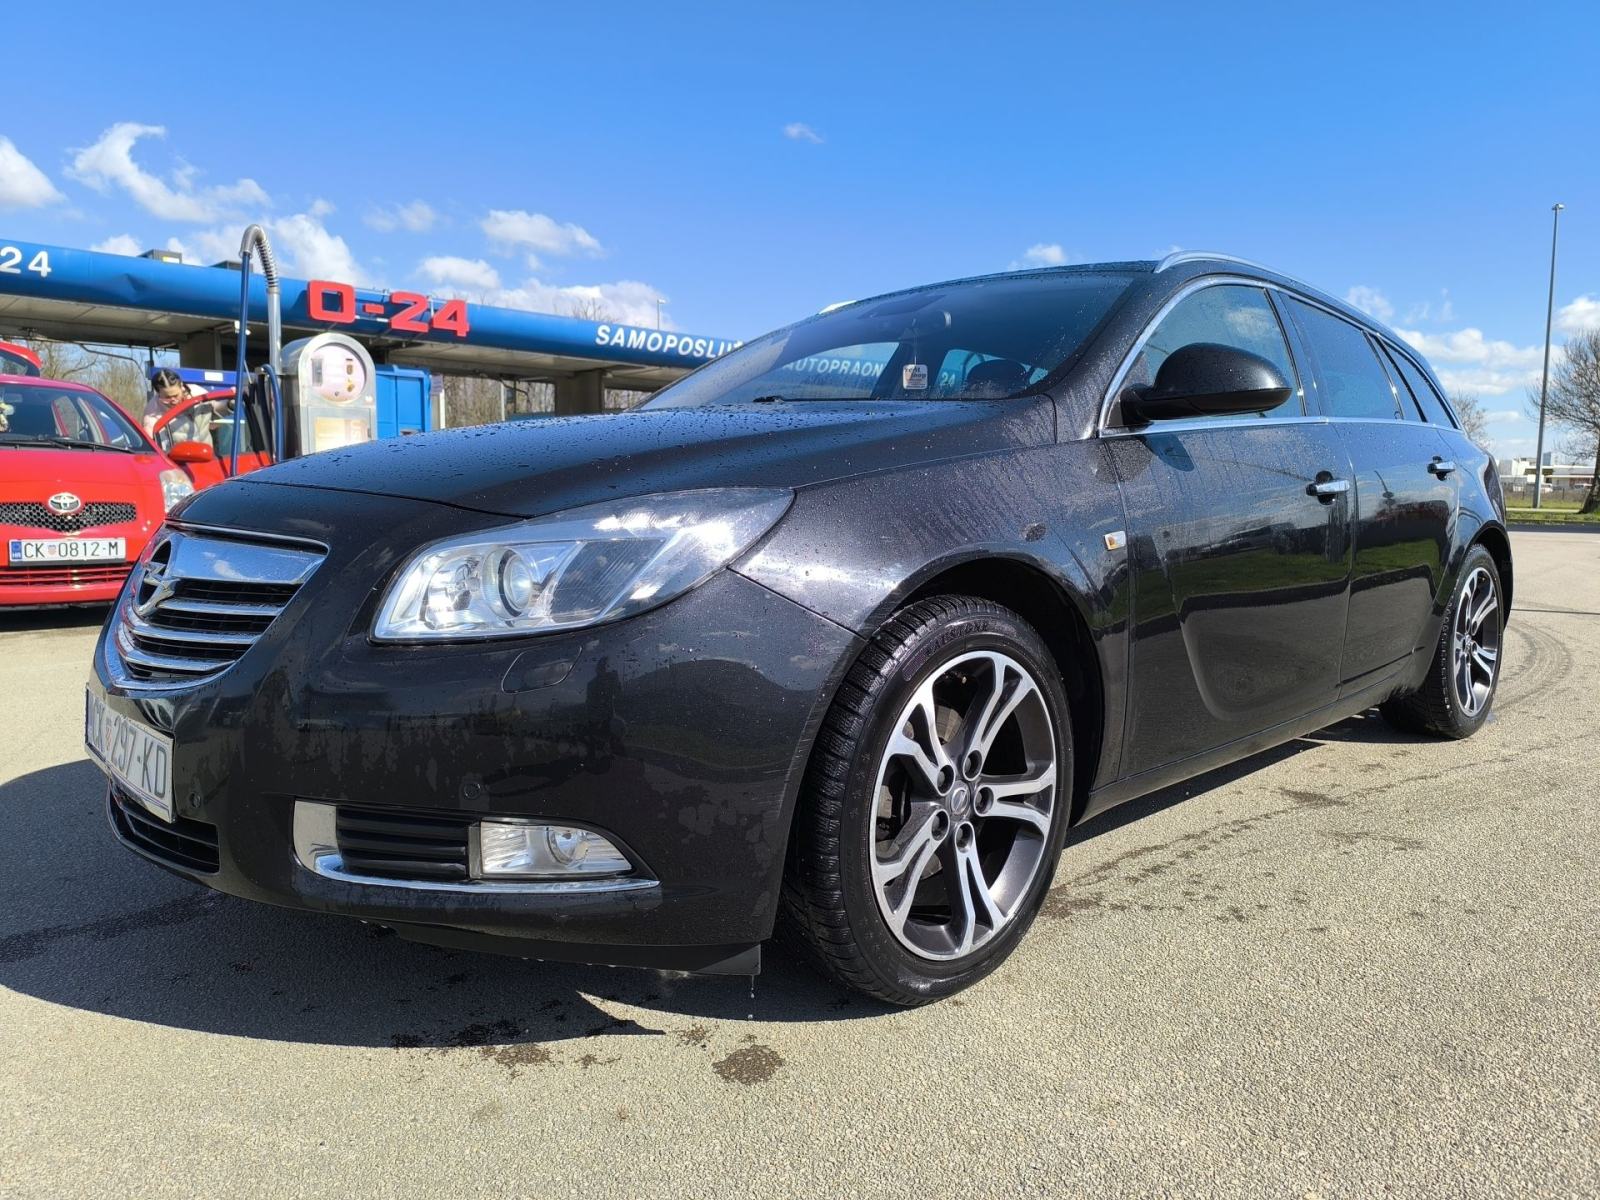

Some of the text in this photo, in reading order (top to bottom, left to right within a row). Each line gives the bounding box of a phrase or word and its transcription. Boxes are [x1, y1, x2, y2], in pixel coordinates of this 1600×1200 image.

[0, 246, 52, 278] 24
[594, 324, 744, 359] SAMOPOSLU
[783, 357, 887, 377] AUTOPRAON
[24, 541, 119, 558] CK 0812-M
[110, 713, 168, 799] 297-KD
